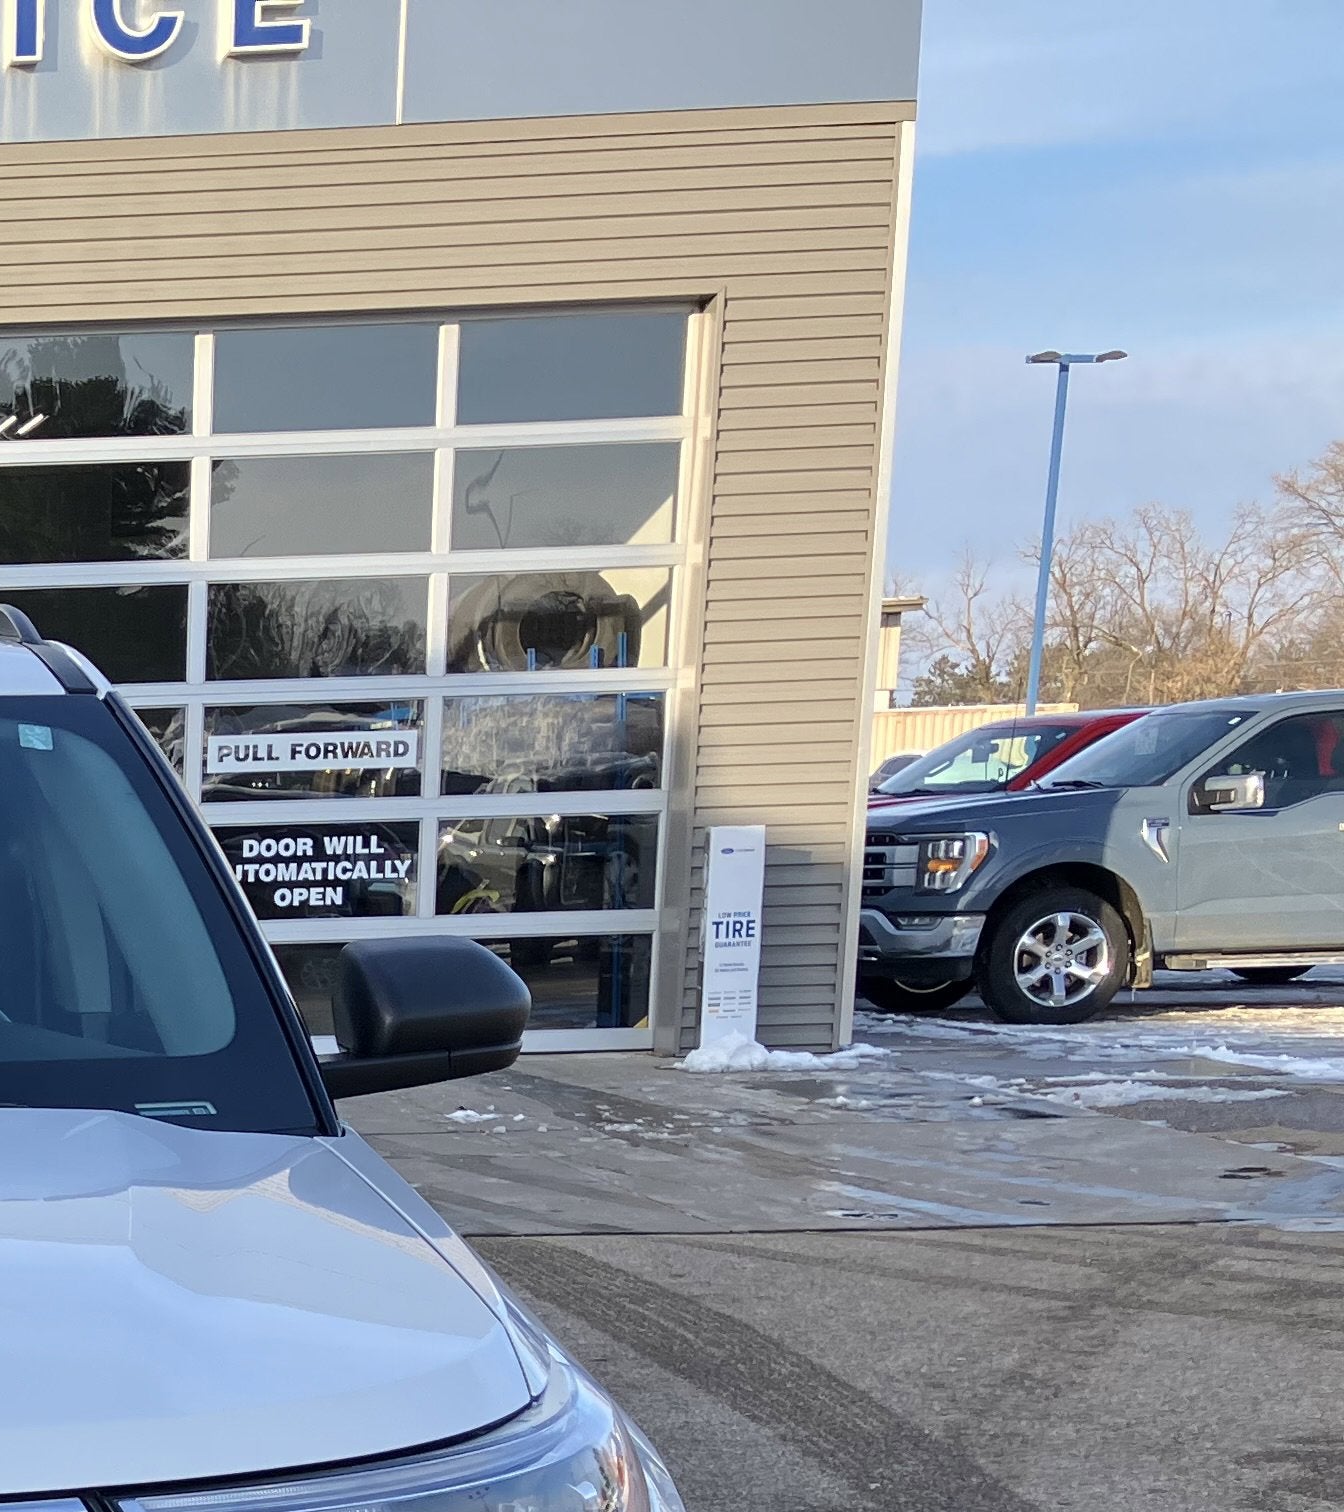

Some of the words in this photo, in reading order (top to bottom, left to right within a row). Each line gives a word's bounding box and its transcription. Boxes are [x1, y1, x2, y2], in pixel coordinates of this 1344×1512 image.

[218, 743, 280, 762] PULL
[290, 740, 410, 761] FORWARD
[242, 837, 313, 858] DOOR
[323, 835, 384, 855] WILL
[235, 859, 411, 882] TOMATICALLY
[273, 887, 343, 907] OPEN
[712, 920, 755, 939] TIRE
